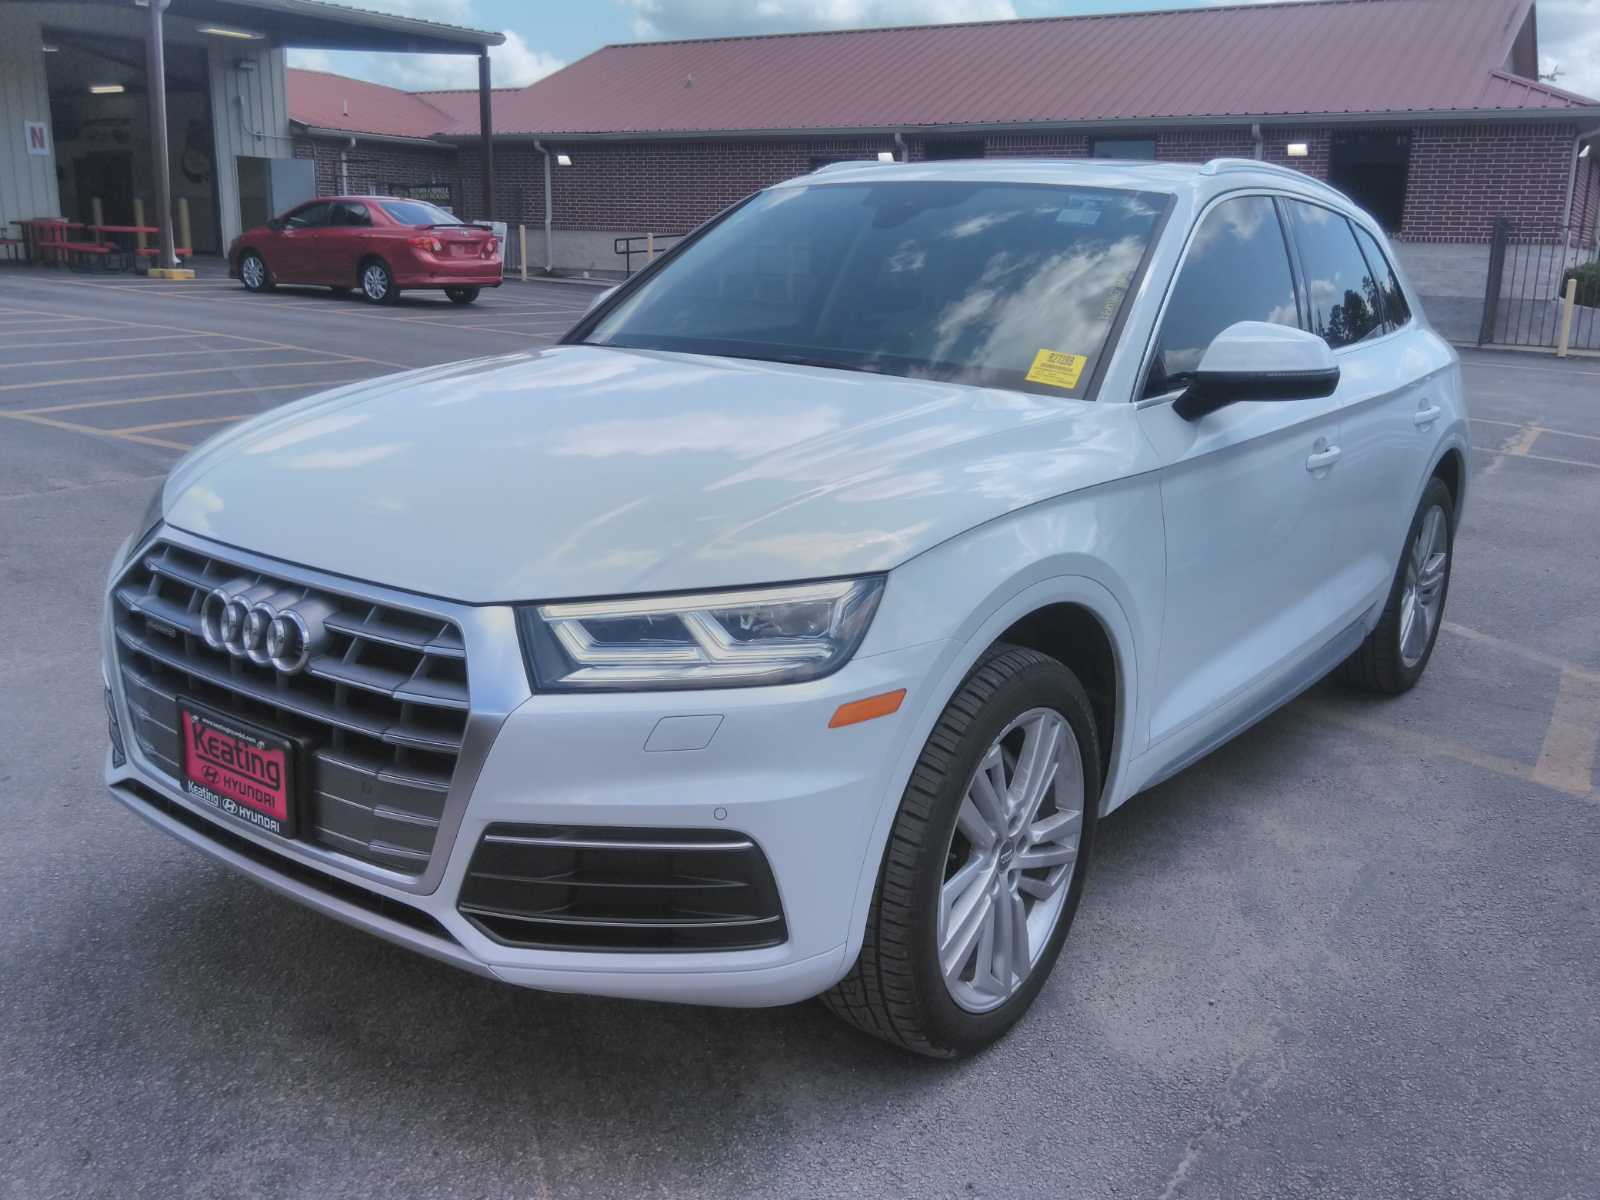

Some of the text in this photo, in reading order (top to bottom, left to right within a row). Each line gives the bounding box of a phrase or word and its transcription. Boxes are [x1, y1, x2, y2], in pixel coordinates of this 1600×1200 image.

[31, 127, 45, 148] N
[190, 723, 280, 789] Keating
[188, 780, 280, 832] Keating HYUNDAI
[223, 776, 275, 808] HYUNDAI
